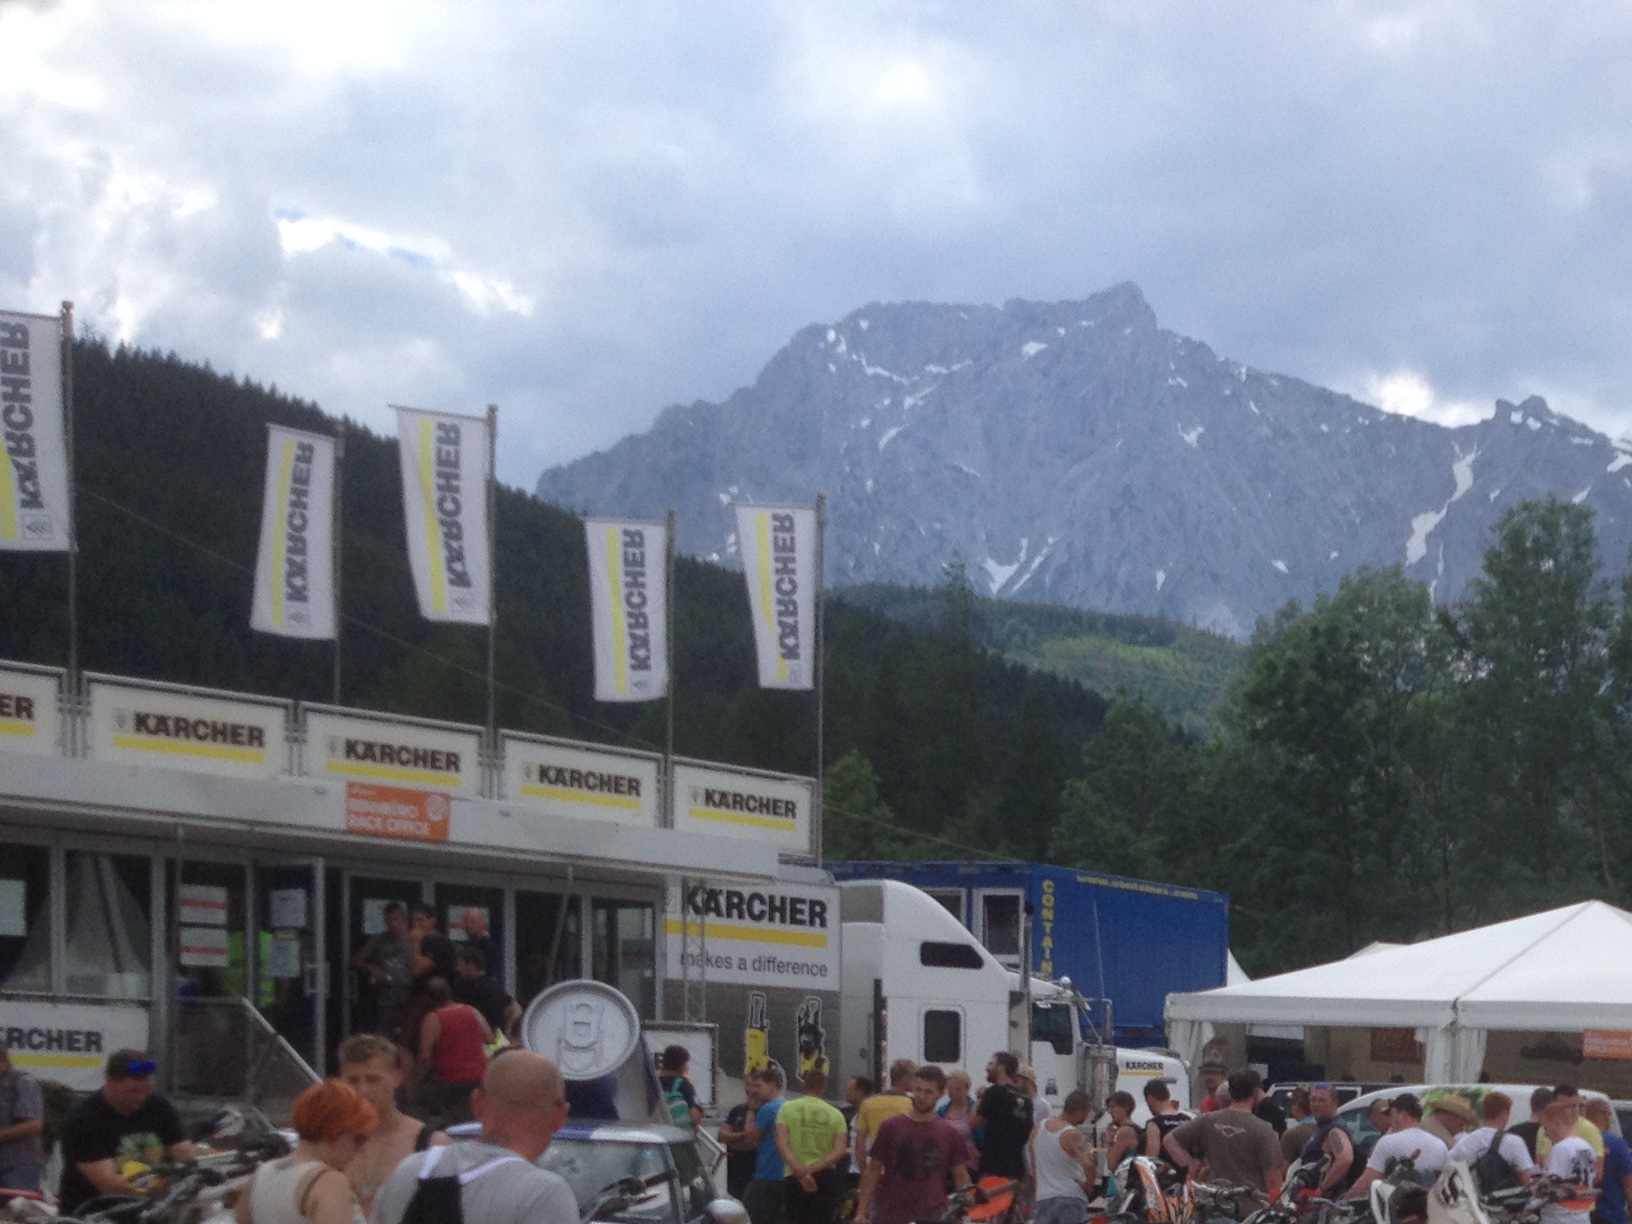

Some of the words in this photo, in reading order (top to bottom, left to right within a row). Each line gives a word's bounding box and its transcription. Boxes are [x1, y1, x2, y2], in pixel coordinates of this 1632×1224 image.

[134, 711, 266, 749] KÄRCHER
[345, 739, 462, 773] KÄRCHER
[538, 763, 642, 798] KÄRCHER
[704, 787, 798, 820] KÄRCHER
[686, 884, 828, 929] KÄRCHER
[737, 958, 748, 971] a
[752, 954, 829, 978] difference
[0, 1026, 103, 1053] RCHER
